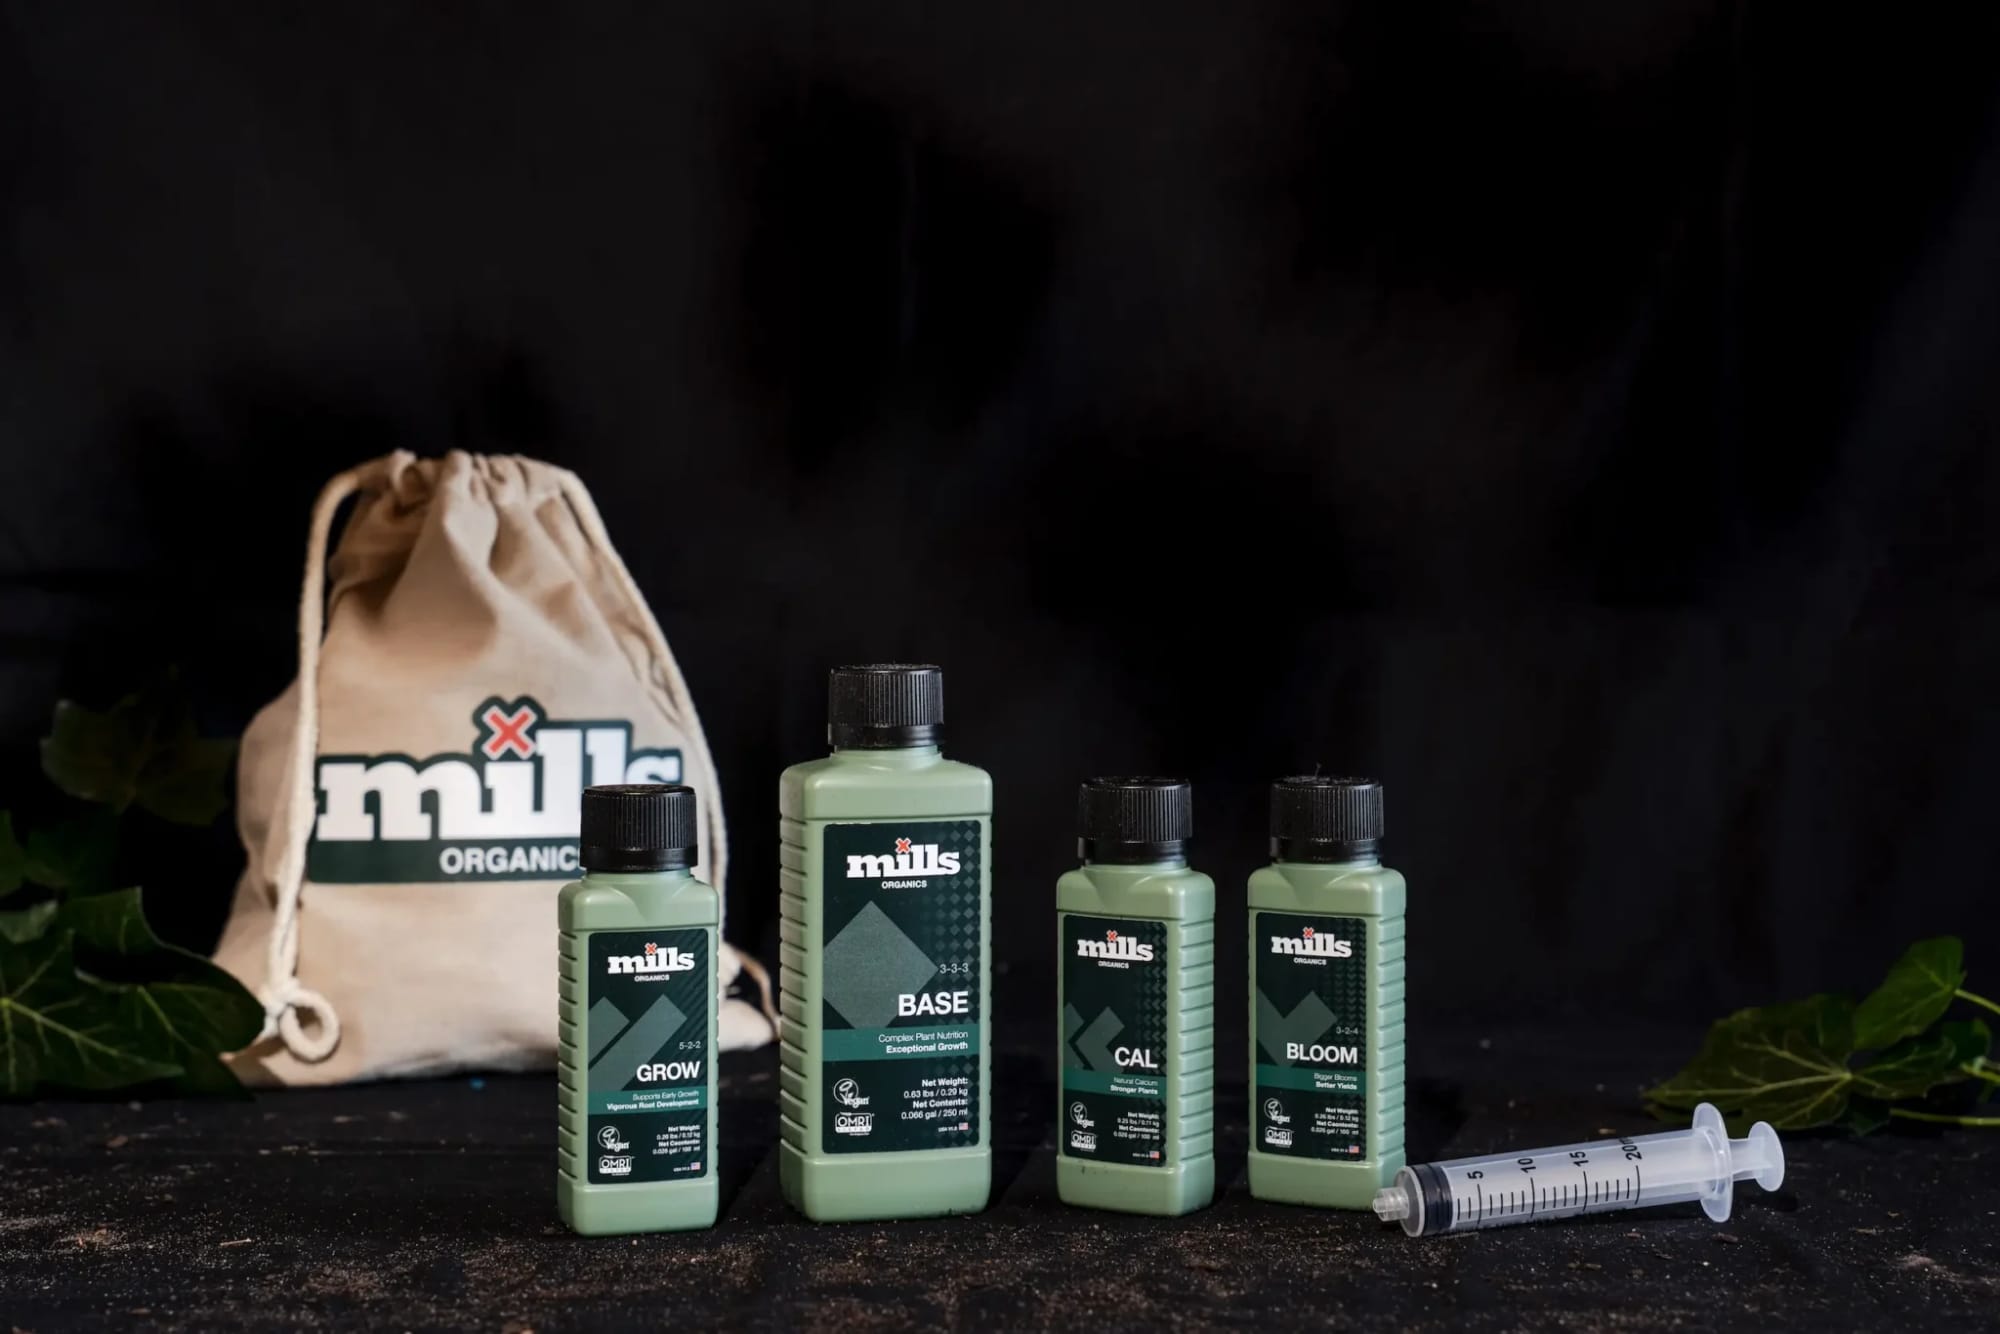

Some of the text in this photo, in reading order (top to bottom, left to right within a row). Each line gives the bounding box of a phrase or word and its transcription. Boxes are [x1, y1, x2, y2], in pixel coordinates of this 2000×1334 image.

[440, 846, 580, 874] ORGANIC
[847, 837, 961, 878] mills
[882, 880, 927, 889] ORGANICS
[1077, 930, 1154, 962] mills
[1271, 927, 1352, 958] mills
[608, 943, 695, 974] mills
[1098, 960, 1129, 969] ORGANICS
[1293, 957, 1327, 965] ORGANICS
[939, 963, 969, 974] 3-3-3
[634, 974, 670, 982] ORGANICS
[898, 991, 969, 1017] BASE
[1336, 1026, 1358, 1035] 3-2-4
[879, 1030, 968, 1044] Complex Plant Nutrition
[679, 1041, 700, 1050] 5-2-2
[886, 1041, 968, 1054] Exceptional Growth
[1114, 1047, 1158, 1068] CAL
[1287, 1042, 1358, 1064] BLOOM
[636, 1061, 700, 1082] GROW
[922, 1077, 968, 1087] Net Weight:
[1315, 1081, 1357, 1090] Better Yields
[923, 1089, 935, 1097] lbs
[959, 1087, 968, 1097] kg
[1110, 1084, 1158, 1095] Stronger Plants
[633, 1090, 699, 1102] Supports Early Growth
[607, 1103, 637, 1112] Vigorous
[656, 1099, 699, 1108] Development
[913, 1099, 968, 1109] Net Contents:
[925, 1110, 937, 1120] gal
[959, 1108, 968, 1116] ml
[838, 1116, 870, 1127] OMRI
[601, 1158, 630, 1168] OMRI
[1569, 1151, 1589, 1167] 15
[1517, 1158, 1536, 1173] 10
[1467, 1171, 1483, 1179] 5
